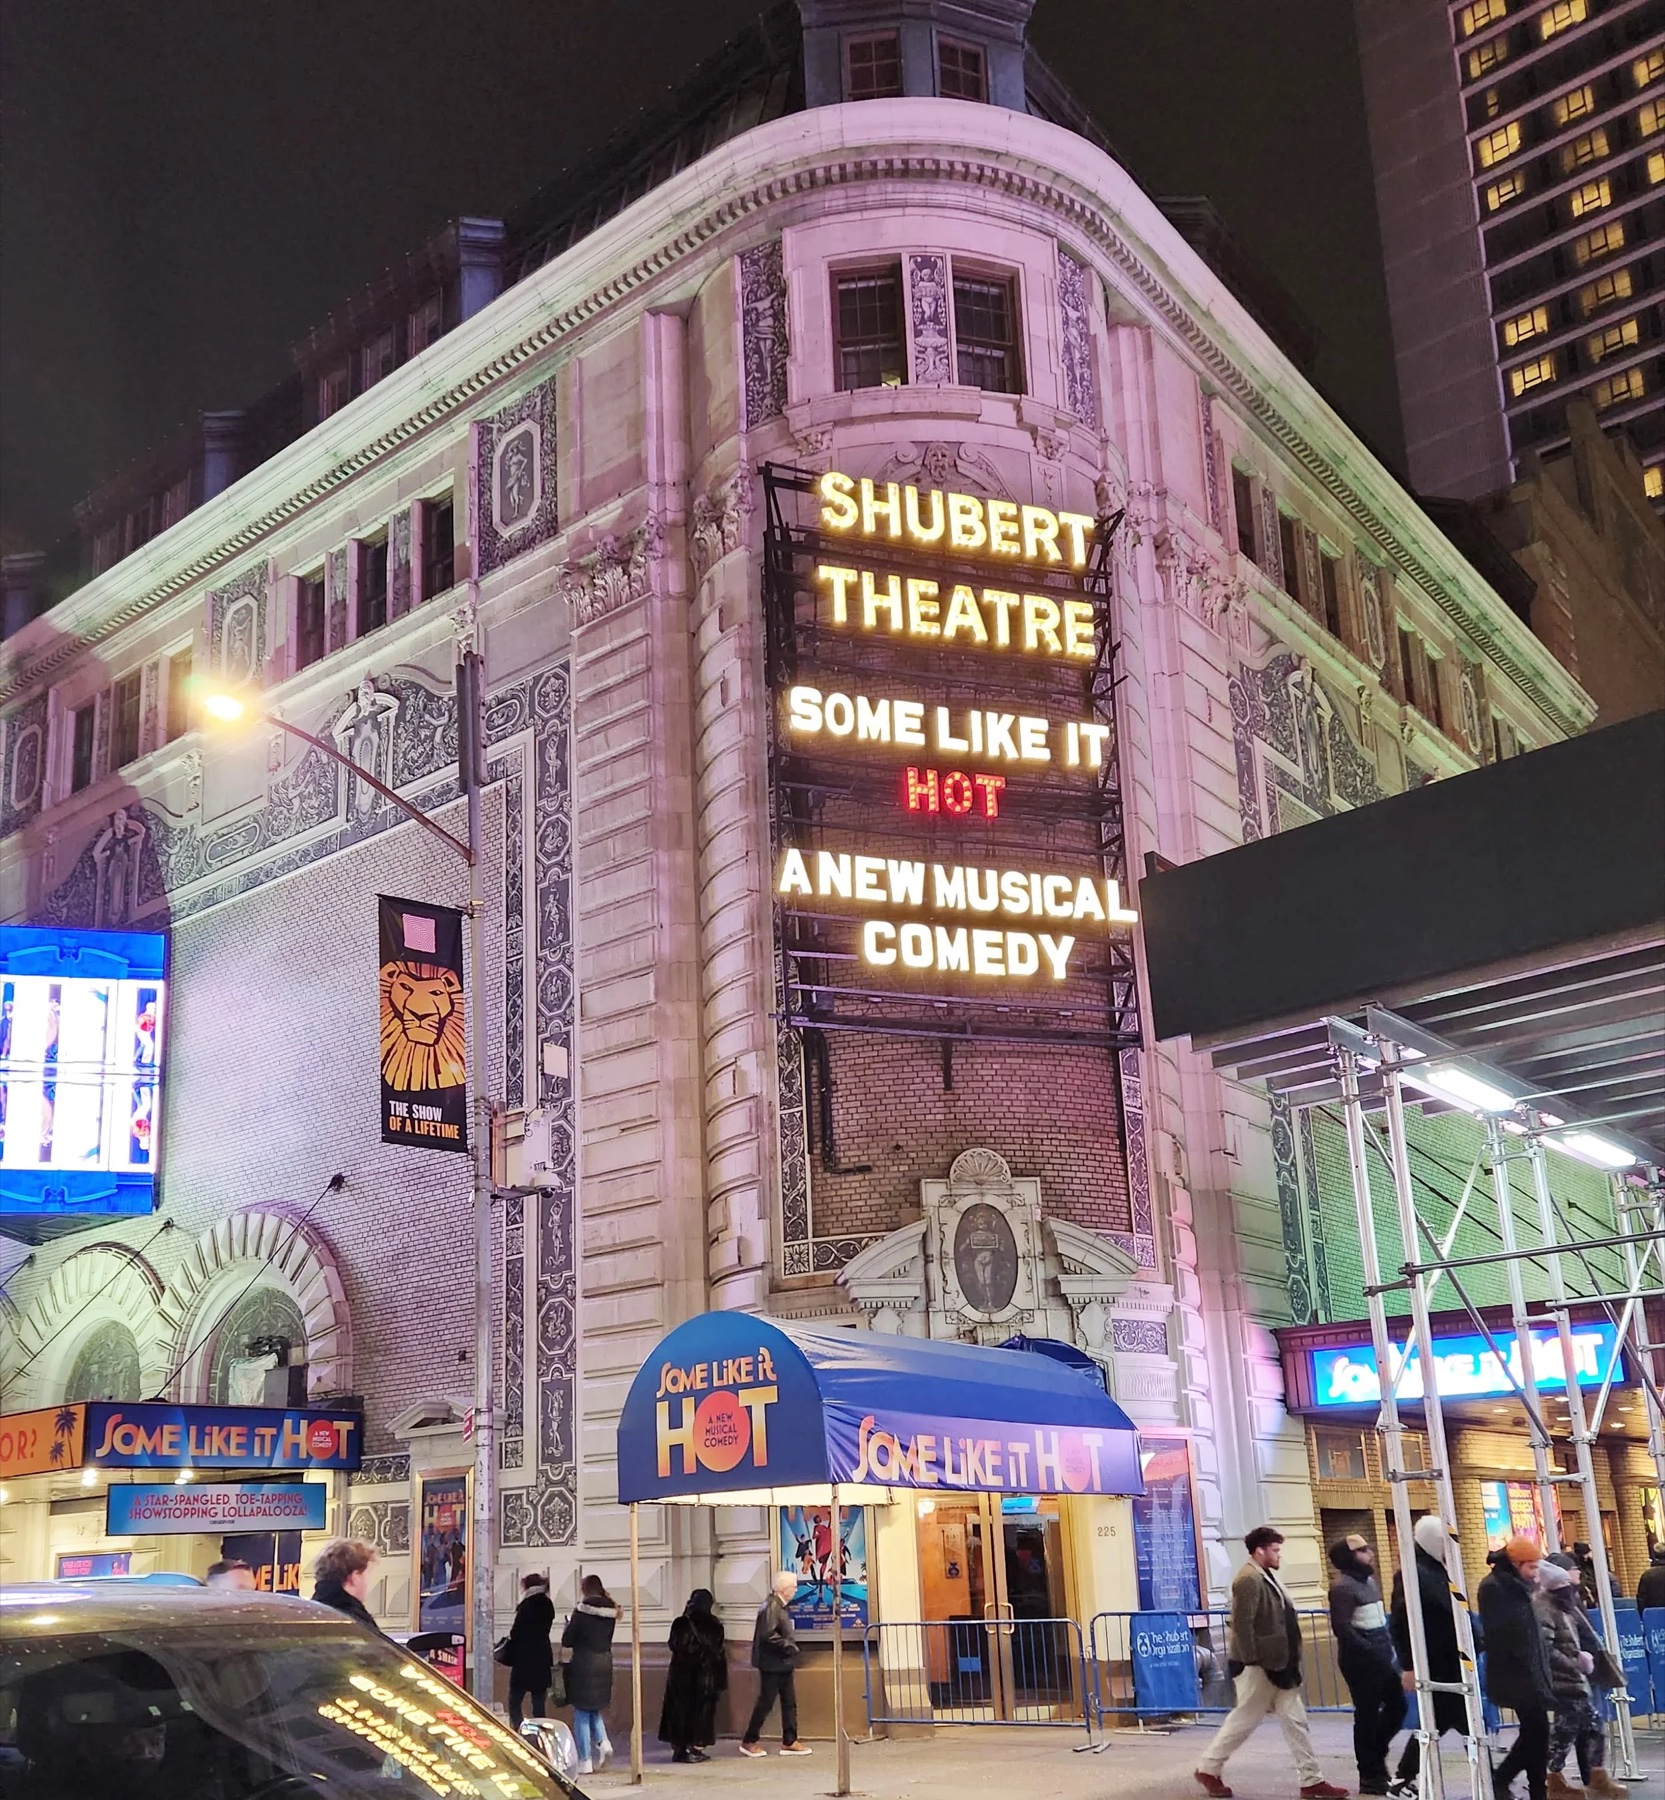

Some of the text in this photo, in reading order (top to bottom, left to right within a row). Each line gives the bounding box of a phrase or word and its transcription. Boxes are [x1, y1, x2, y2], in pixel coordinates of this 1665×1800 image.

[818, 471, 1096, 567] SHUBERT
[817, 564, 1097, 657] THEATRE
[788, 685, 1110, 768] SOME LIKE IT
[904, 766, 1006, 819] HOT
[778, 848, 1139, 924] A NEW MUSICAL
[862, 920, 1076, 980] COMEDY
[389, 1100, 442, 1121] THE SHOW
[389, 1116, 460, 1139] OF A LIFETIME
[657, 1361, 709, 1399] SOME
[656, 1385, 778, 1478] HOT
[705, 1423, 737, 1436] MUSICAL
[708, 1412, 733, 1423] A NEW
[95, 1413, 181, 1457] SOME
[283, 1418, 354, 1460] HOT
[704, 1435, 739, 1448] COMEDY
[852, 1415, 938, 1484] SOME
[1034, 1430, 1103, 1492] HOT
[129, 1505, 308, 1519] SHOWSTOPPING LOLLAPALOOZA!
[134, 1495, 141, 1506] A
[1097, 1526, 1116, 1537] 225
[430, 1649, 436, 1660] A
[1150, 1643, 1189, 1658] Orgaization
